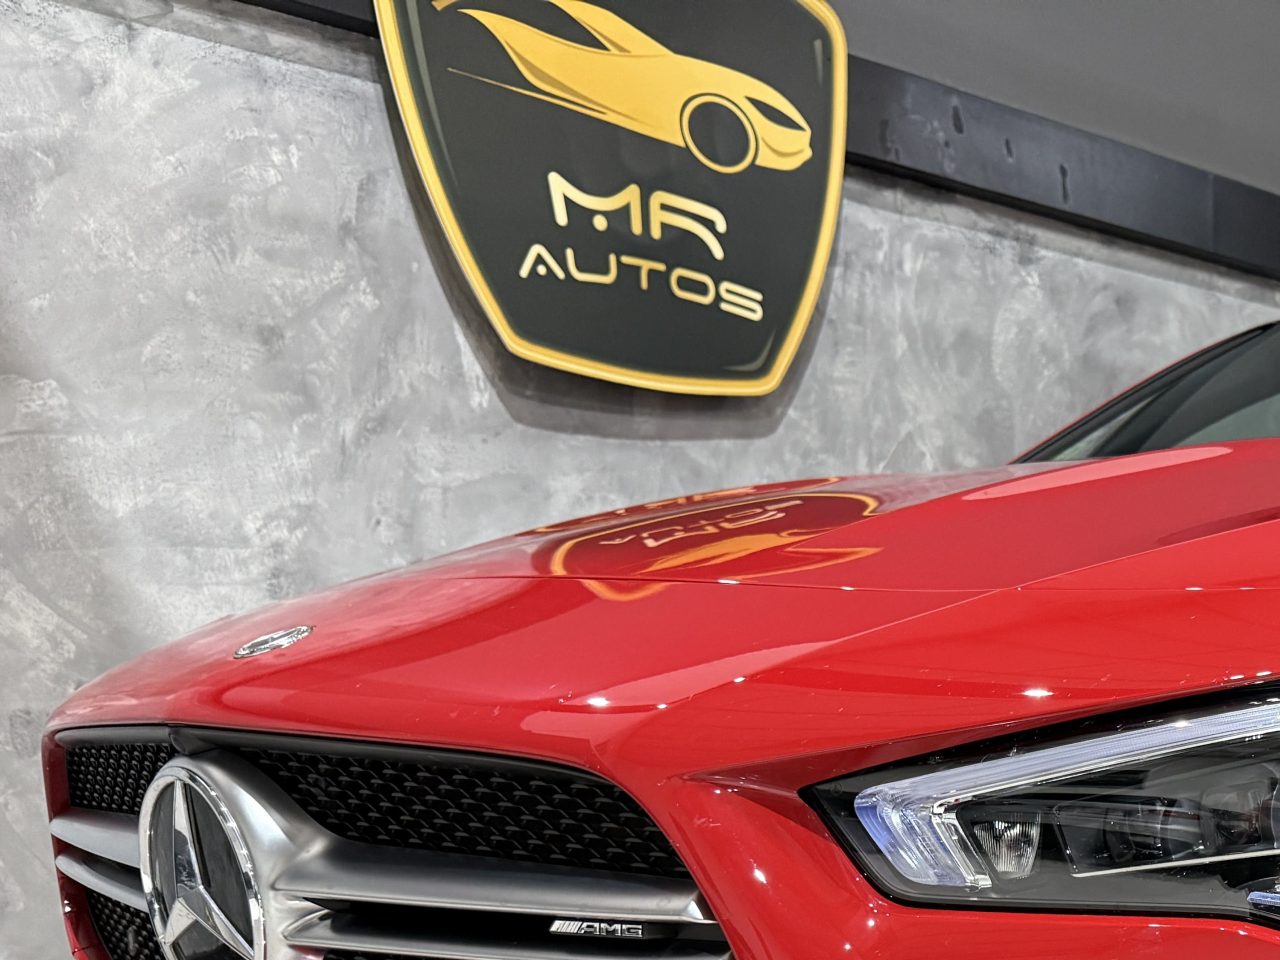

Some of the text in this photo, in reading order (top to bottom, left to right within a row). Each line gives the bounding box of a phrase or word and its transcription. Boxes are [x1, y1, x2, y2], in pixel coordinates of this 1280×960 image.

[548, 171, 727, 260] MR
[519, 244, 764, 321] AUTOS
[577, 921, 643, 938] AMG
